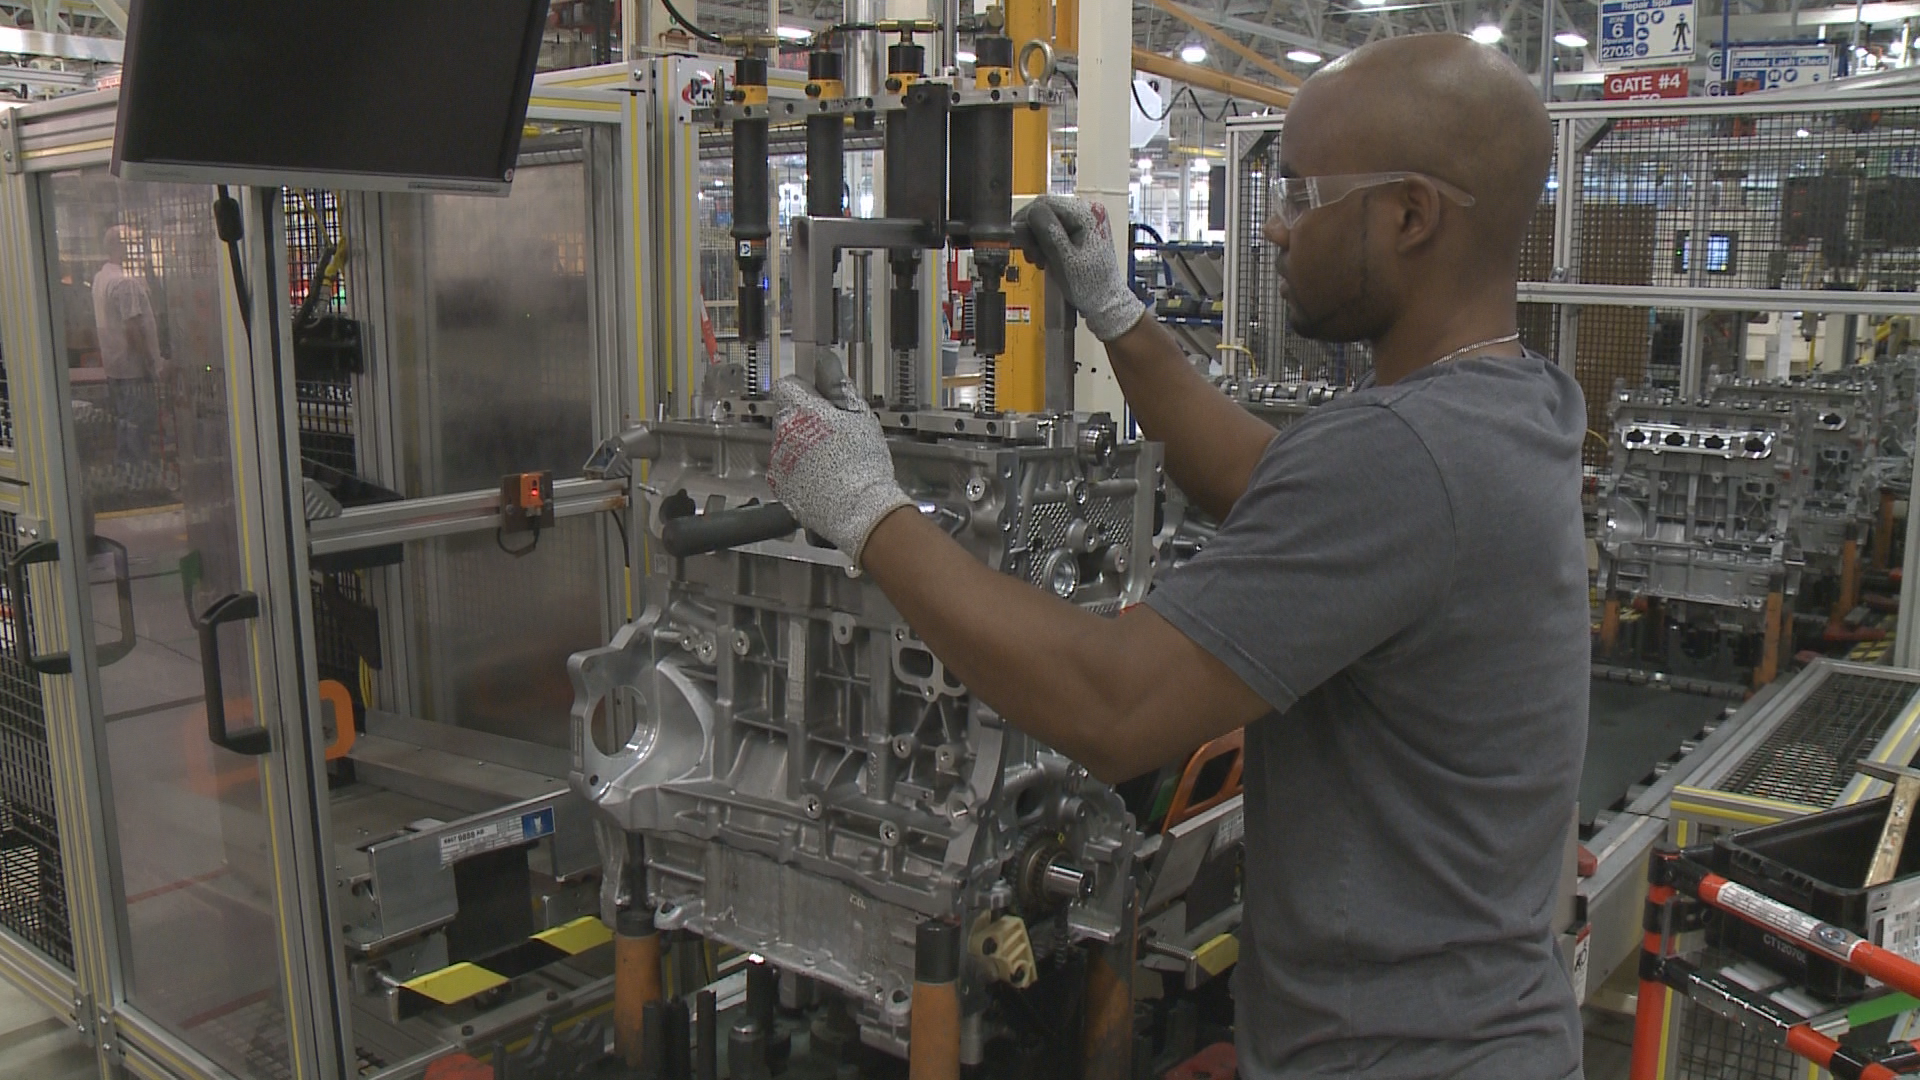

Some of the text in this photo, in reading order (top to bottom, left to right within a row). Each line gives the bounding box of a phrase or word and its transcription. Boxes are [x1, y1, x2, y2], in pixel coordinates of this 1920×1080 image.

[1621, 2, 1648, 11] Repair
[1612, 23, 1623, 38] 6
[1603, 37, 1632, 45] Operation
[1602, 44, 1633, 57] 270.3
[1734, 57, 1828, 67] Exhaust Lash Check
[1611, 73, 1681, 93] GATE #4
